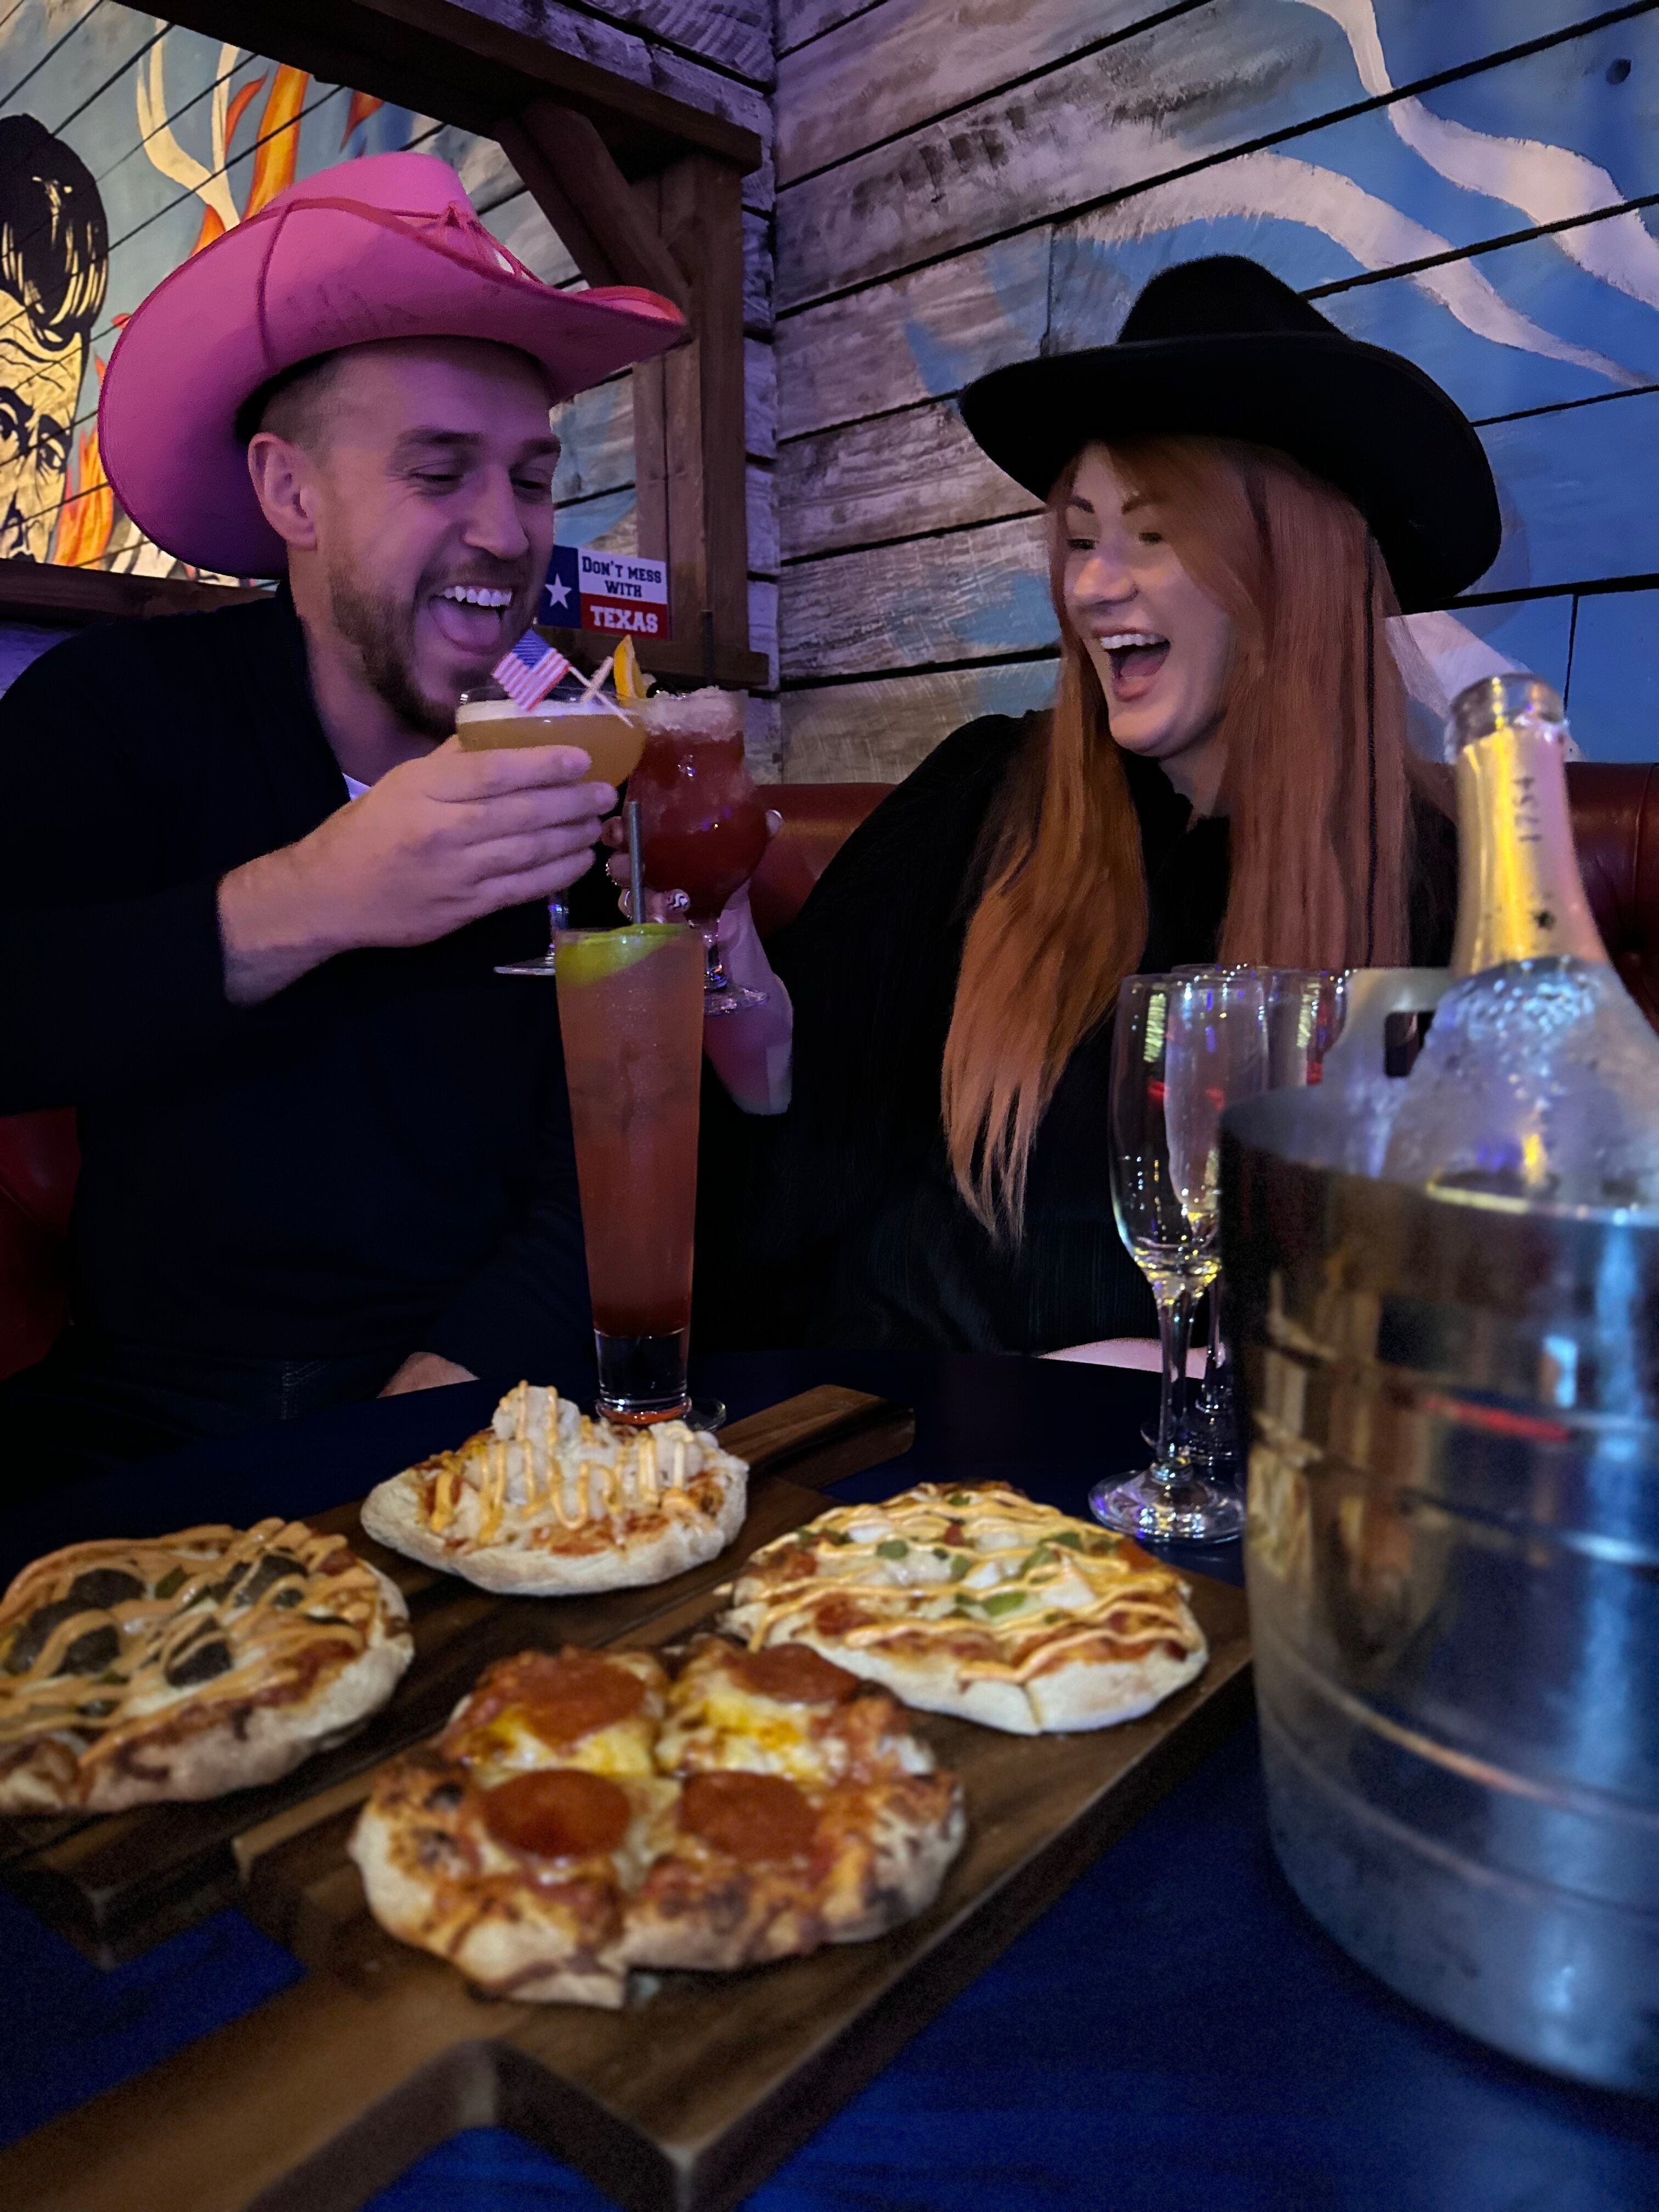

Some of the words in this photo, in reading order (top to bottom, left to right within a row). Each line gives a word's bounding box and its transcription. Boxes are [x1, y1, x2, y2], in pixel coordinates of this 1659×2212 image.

[582, 556, 623, 578] DON'T
[628, 566, 662, 584] MESS
[605, 580, 642, 598] WITH
[590, 605, 658, 634] TEXAS
